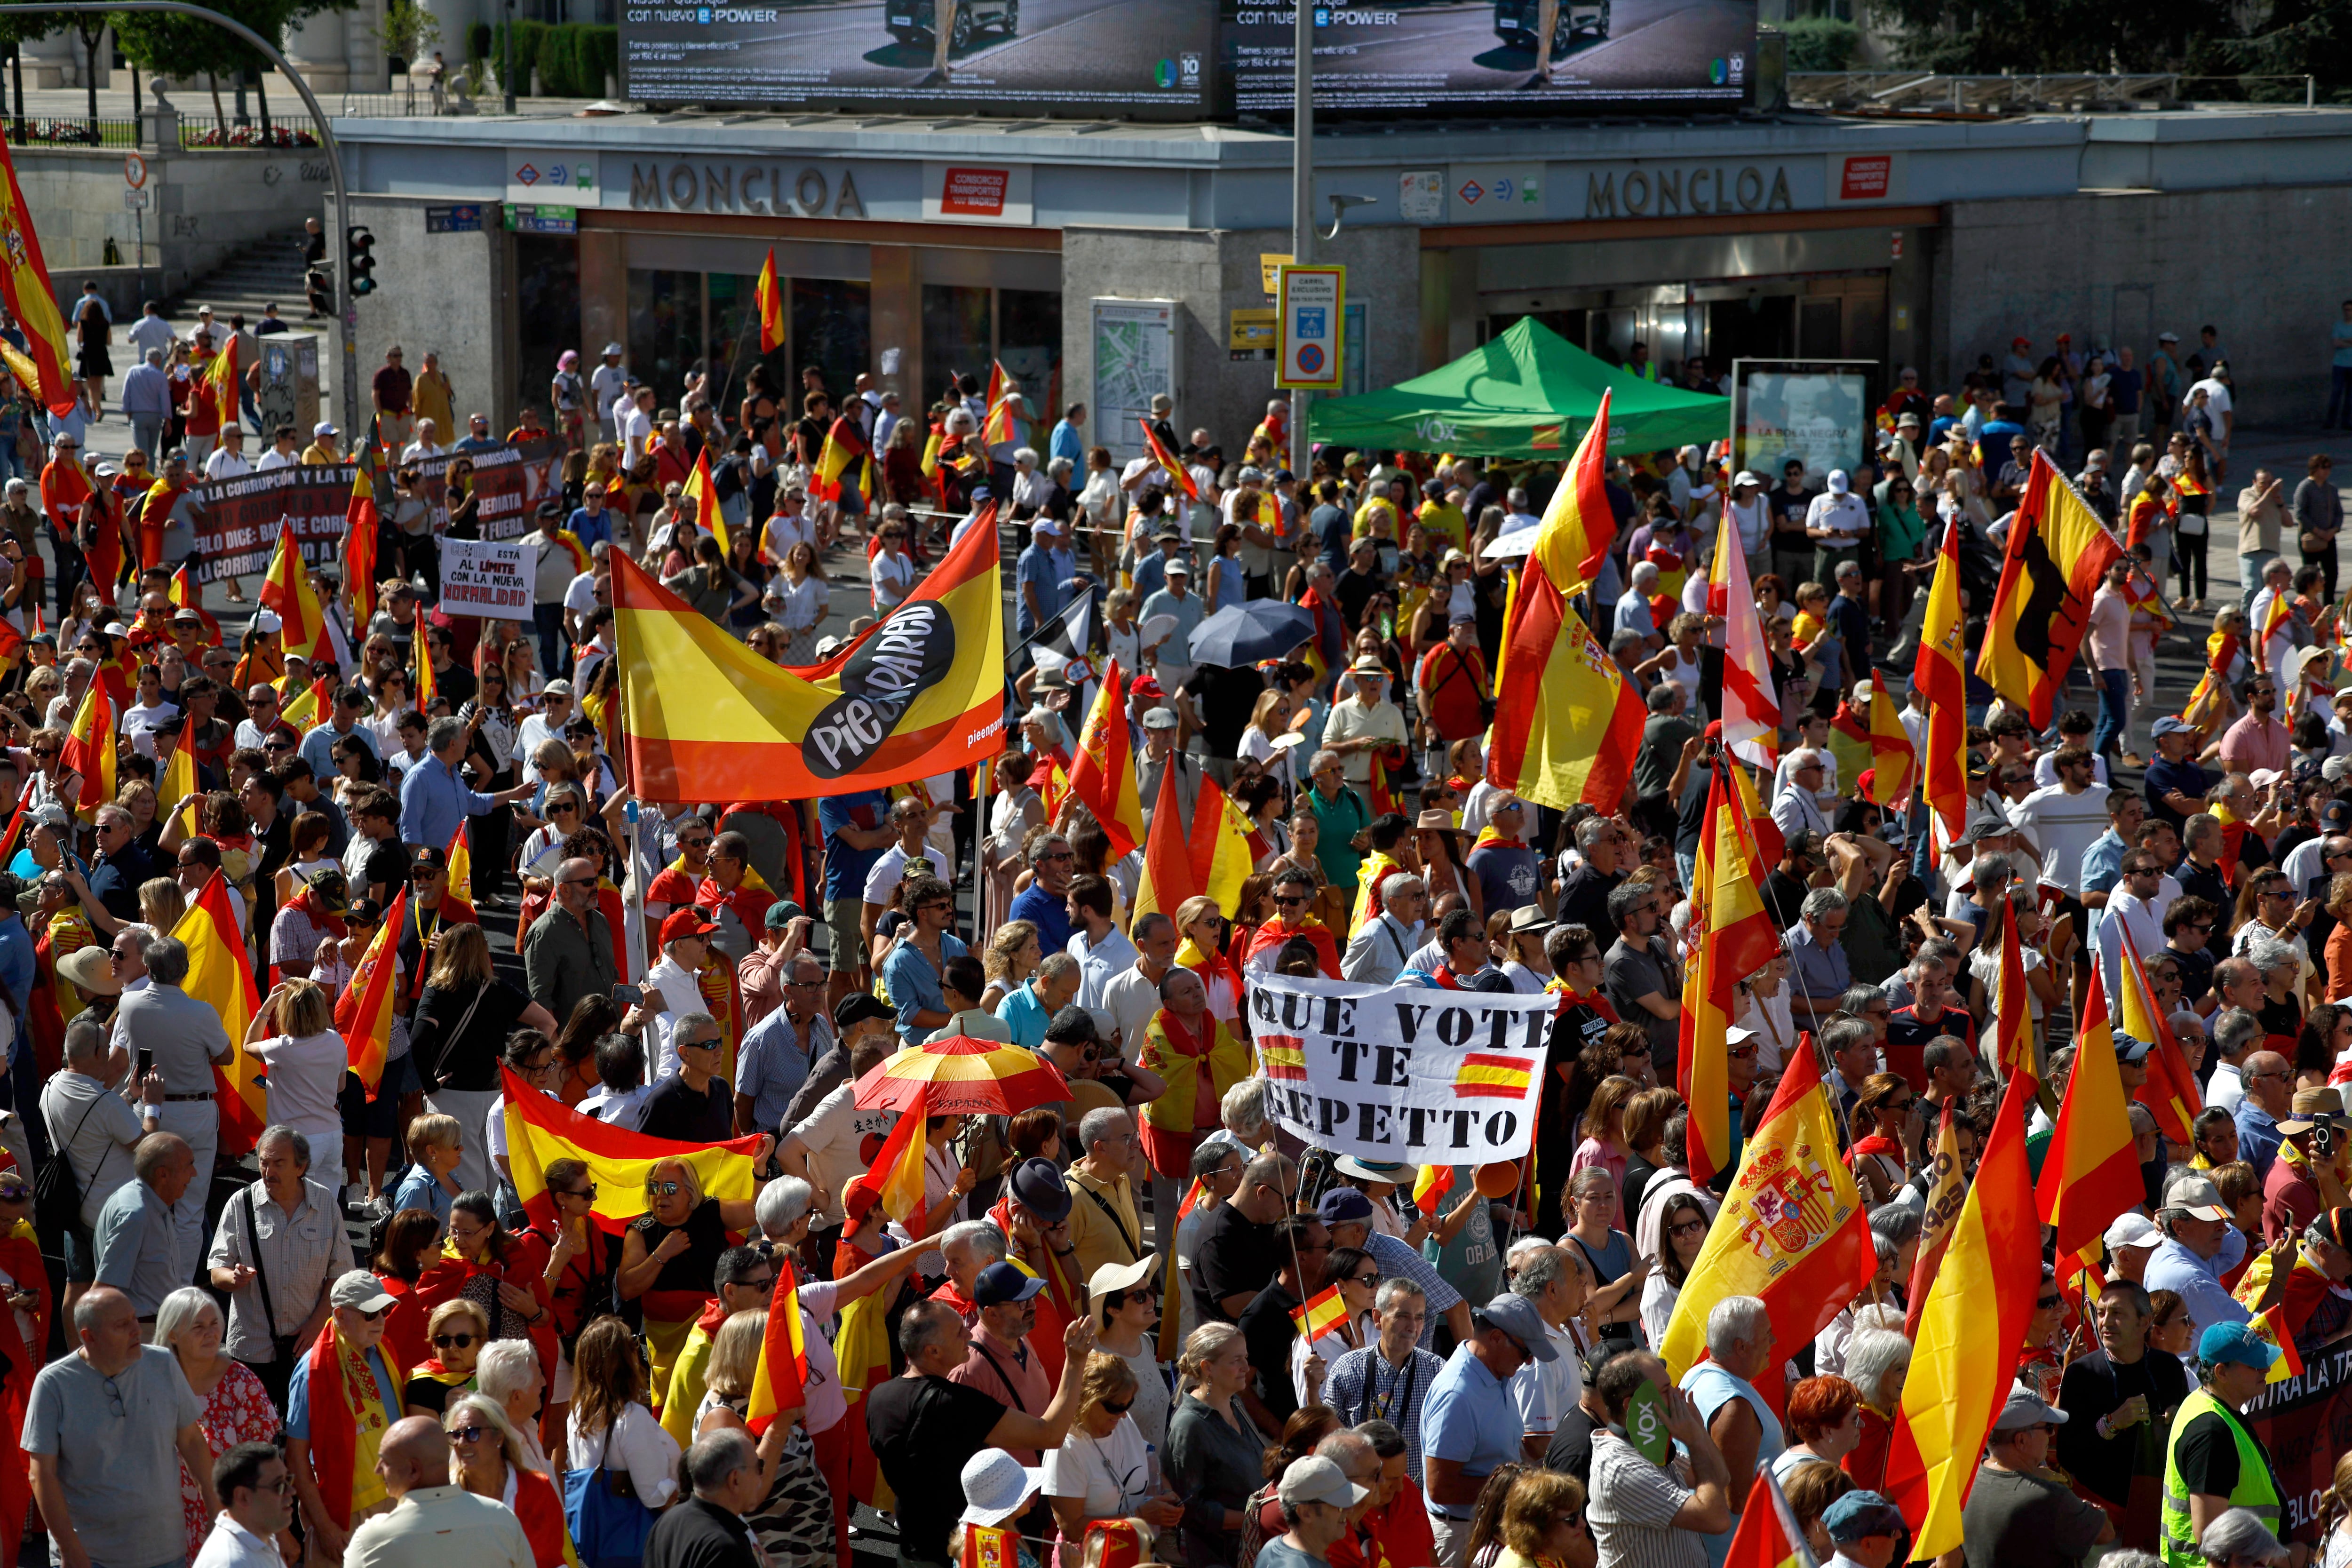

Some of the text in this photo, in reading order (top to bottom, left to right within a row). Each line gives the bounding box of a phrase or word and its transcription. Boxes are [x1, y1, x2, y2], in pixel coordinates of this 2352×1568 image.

[627, 9, 651, 22] con
[654, 9, 696, 22] nuevo
[1236, 10, 1265, 24] con
[1182, 59, 1199, 74] 10
[954, 174, 1004, 186] CONSORCIO
[629, 163, 865, 219] MONCLOA
[949, 184, 1001, 197] TRANSPORTES
[1585, 166, 1793, 218] MONCLOA
[968, 197, 1000, 207] MADRID
[1415, 417, 1457, 442] VOX
[1758, 429, 1848, 438] LA BOLA NEGRA
[472, 448, 522, 469] DIMISIÓN
[208, 487, 225, 502] LA
[301, 470, 311, 484] Y
[316, 468, 336, 483] LA
[488, 516, 525, 541] FUERA
[451, 542, 520, 560] CEUTA ESTÁ
[459, 559, 516, 575] AL LÍMITE
[451, 572, 524, 588] CON LA NUEVA
[1510, 864, 1533, 879] DOCKERS
[1252, 987, 1558, 1049] QUE VOTE
[1332, 1039, 1412, 1087] TE
[1465, 1244, 1484, 1266] OR
[2306, 1358, 2330, 1394] LA
[1637, 1401, 1656, 1446] VOX
